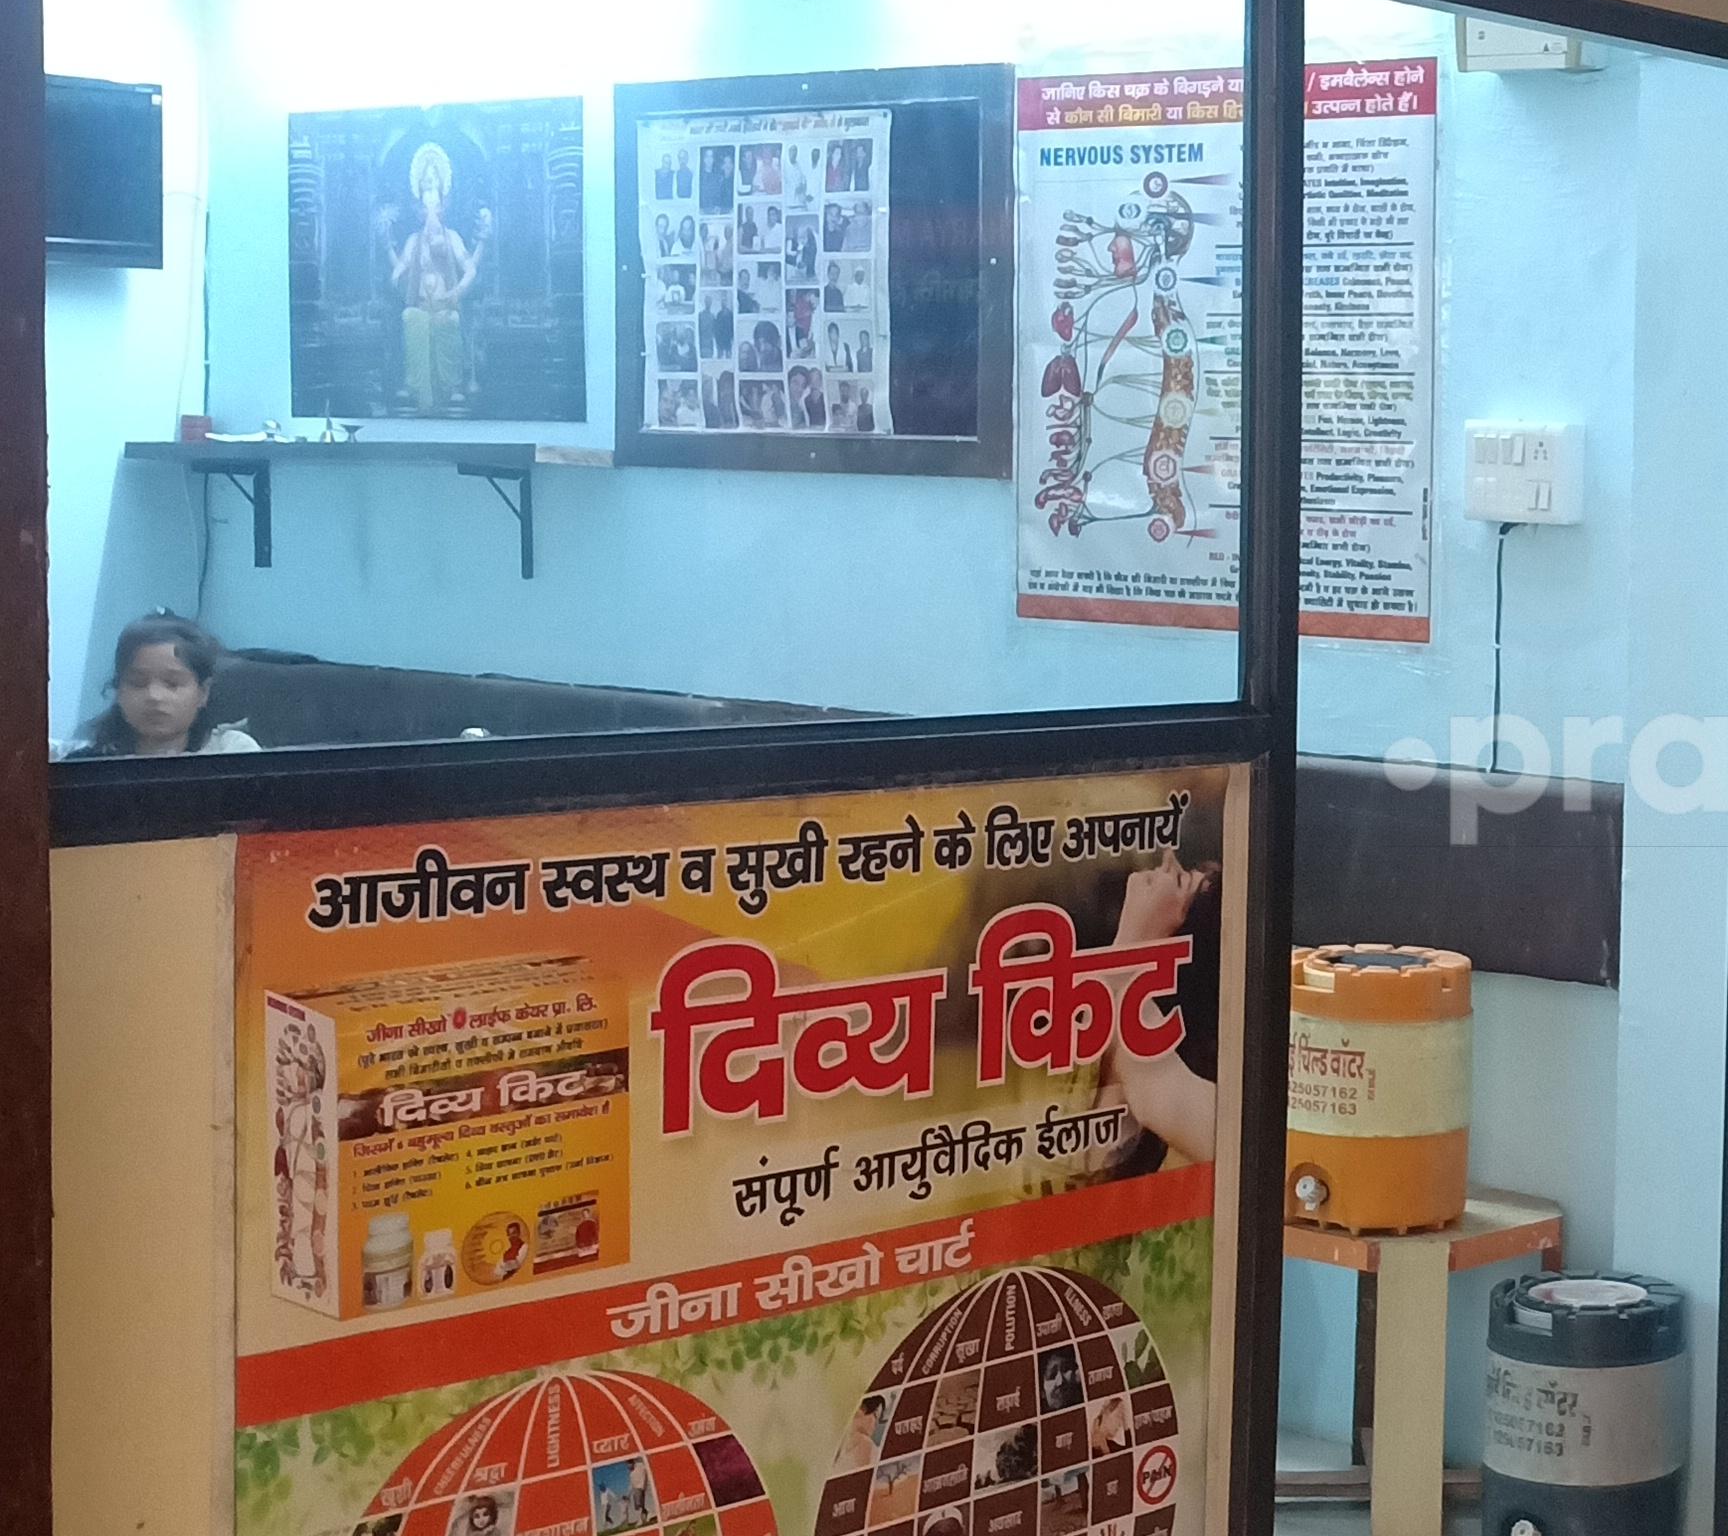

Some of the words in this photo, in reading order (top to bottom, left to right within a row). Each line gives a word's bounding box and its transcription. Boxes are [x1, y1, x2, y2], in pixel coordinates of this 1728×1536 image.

[1089, 80, 1120, 98] किस
[1153, 79, 1169, 95] के
[1394, 66, 1424, 85] होने
[1046, 107, 1060, 125] से
[1097, 105, 1114, 122] सी
[1166, 107, 1183, 119] या
[1187, 101, 1218, 119] किस
[1365, 94, 1393, 112] होते
[1040, 145, 1123, 166] NERVOUS
[1130, 143, 1203, 164] SYSTEM
[309, 849, 529, 928] आजीवन
[542, 852, 669, 908] स्वस्थ
[682, 848, 714, 893] व
[727, 819, 825, 913] सुखी
[840, 816, 922, 881] रहने
[934, 811, 975, 868] के
[986, 807, 1053, 866] लिए
[1063, 791, 1189, 857] अपनायें
[367, 1022, 403, 1044] जीना
[408, 1017, 447, 1037] सीखो
[651, 940, 947, 1137] दिव्य
[970, 904, 1192, 1087] किट
[383, 1089, 484, 1127] दिव्य
[499, 1070, 587, 1107] किट
[1289, 1081, 1357, 1099] 25057162
[733, 1146, 839, 1226] संपूर्ण
[1036, 1105, 1127, 1160] ईलाज
[607, 1279, 739, 1340] जीना
[756, 1245, 882, 1310] सीखो
[896, 1220, 974, 1274] चार्ट
[1064, 1287, 1092, 1327] ILLNESS
[922, 1308, 963, 1374] CORRUPTION
[547, 1384, 560, 1468] LIGHTNESS
[593, 1434, 630, 1453] प्यार
